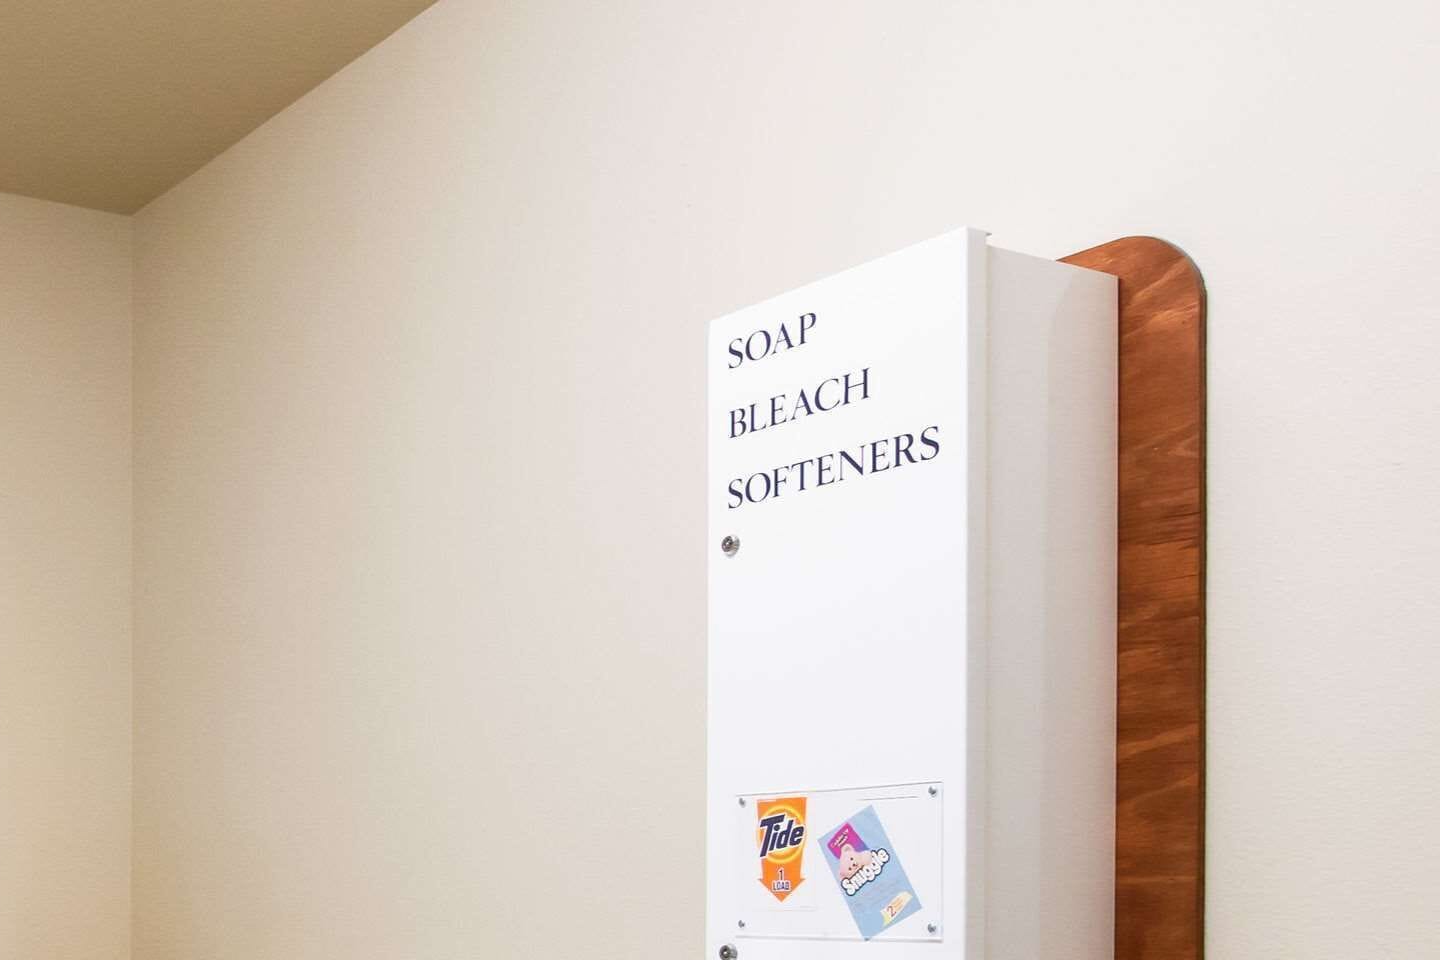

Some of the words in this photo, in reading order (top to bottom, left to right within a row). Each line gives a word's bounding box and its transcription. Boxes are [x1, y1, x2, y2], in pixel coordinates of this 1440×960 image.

[728, 312, 817, 369] SOAP
[729, 367, 870, 439] BLEACH
[728, 425, 940, 509] SOFTENERS
[759, 813, 805, 858] Tide
[773, 881, 790, 891] LOAD
[778, 868, 784, 881] 1
[841, 848, 891, 897] Snuggle
